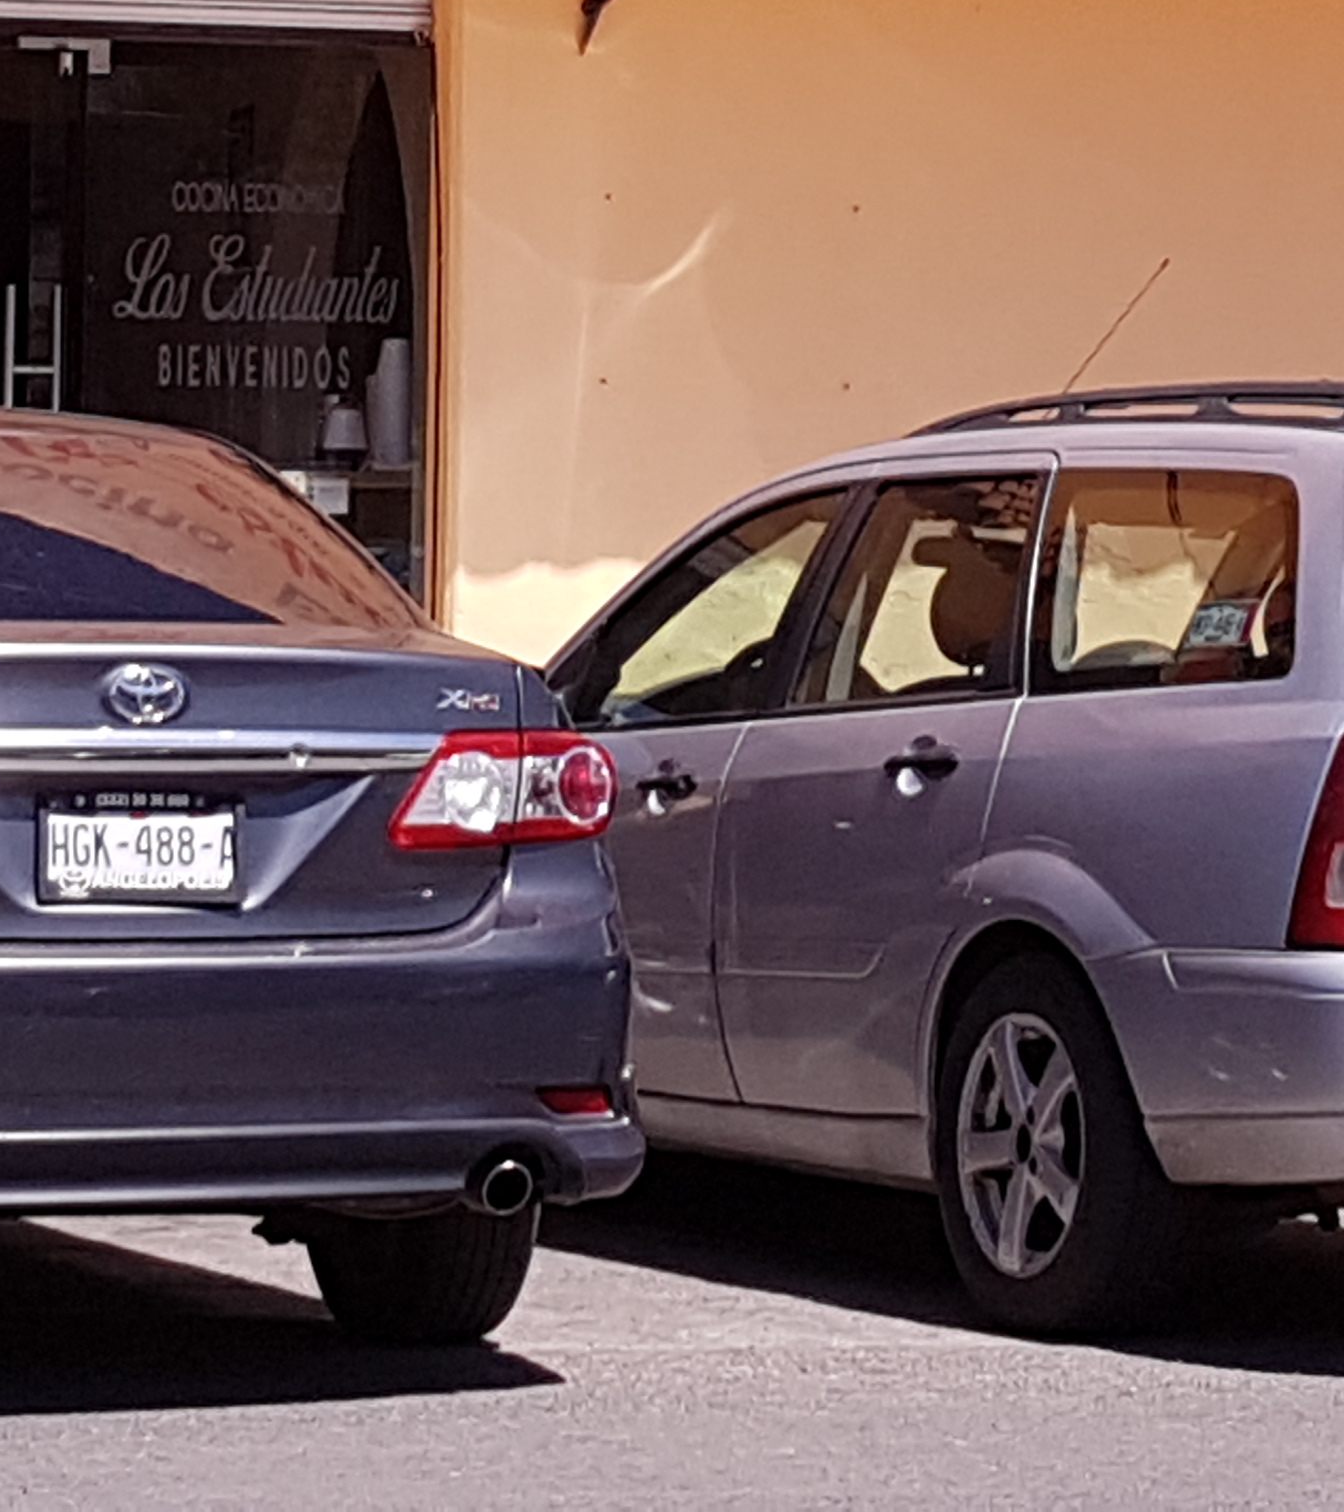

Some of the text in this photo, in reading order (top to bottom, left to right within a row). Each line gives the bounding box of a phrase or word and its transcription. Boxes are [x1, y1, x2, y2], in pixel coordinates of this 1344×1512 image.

[171, 180, 238, 213] COCINA
[111, 233, 400, 324] Los Estudiantes
[156, 342, 352, 392] BIENVENIDOS
[50, 822, 235, 870] HGK-488-A
